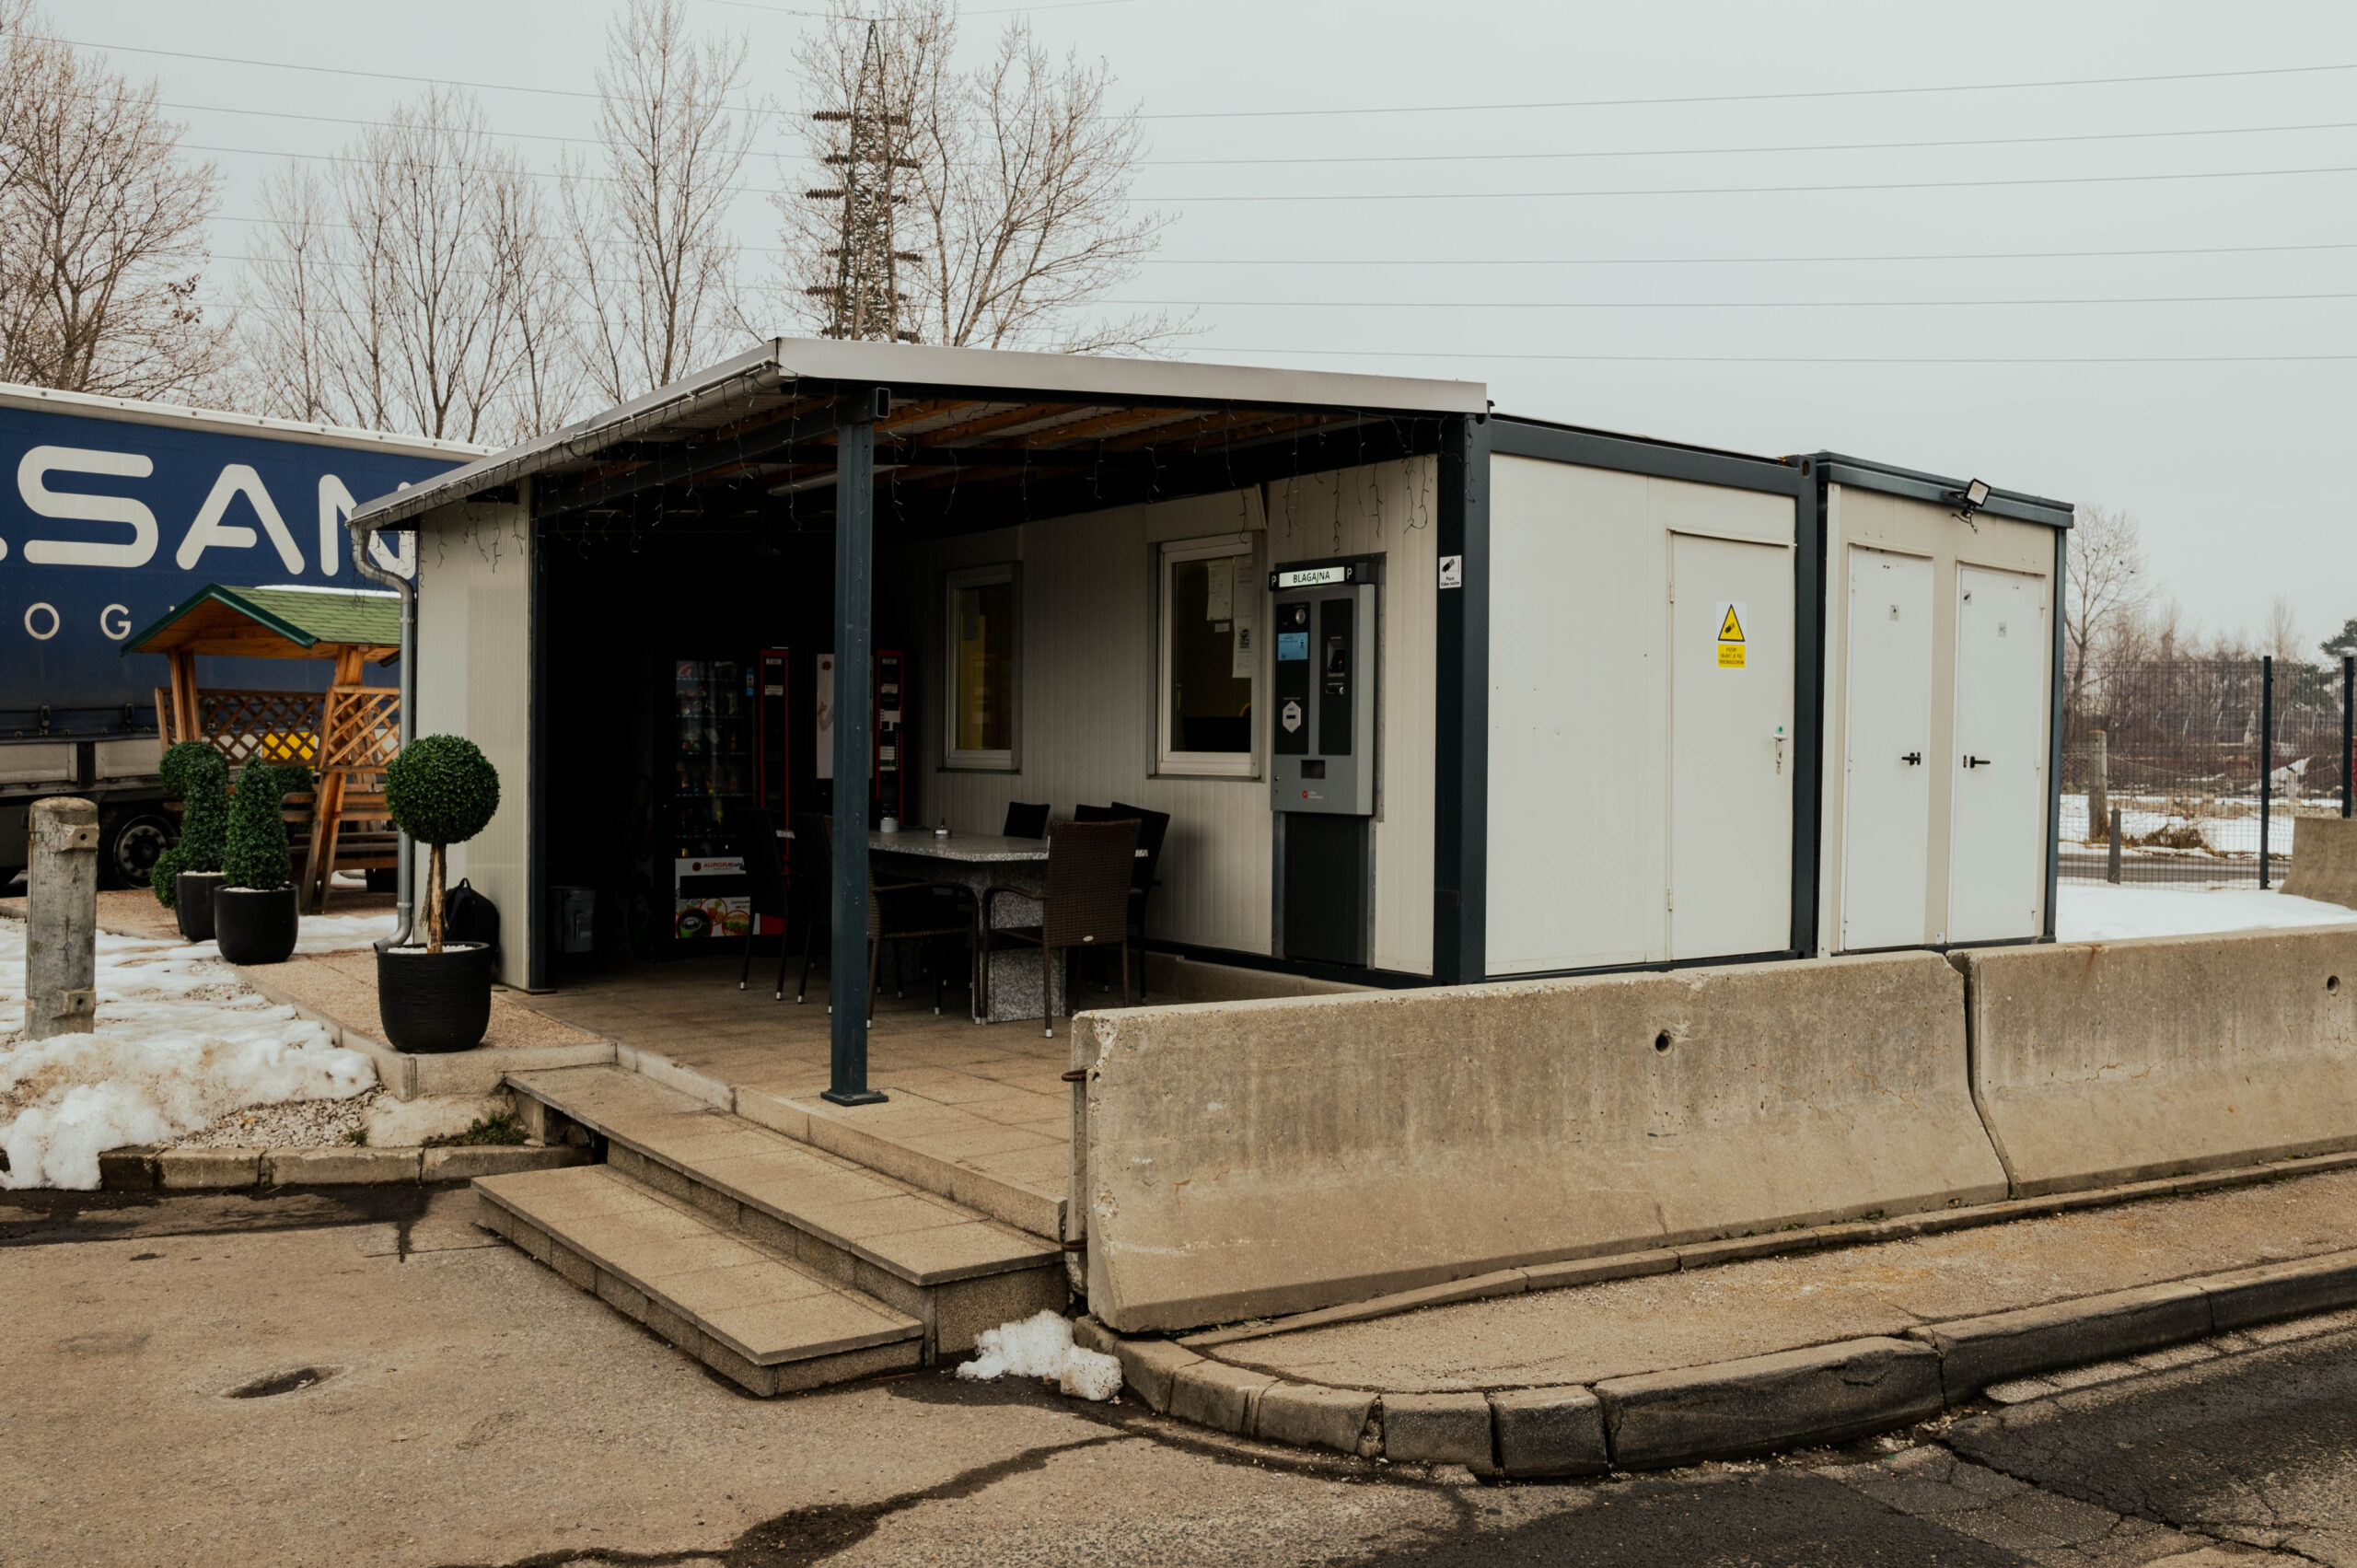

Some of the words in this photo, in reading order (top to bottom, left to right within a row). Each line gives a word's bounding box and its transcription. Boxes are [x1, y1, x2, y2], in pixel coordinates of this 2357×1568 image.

[0, 446, 416, 581] SAN
[1271, 575, 1277, 587] P
[1293, 571, 1330, 584] BLAGAJNA
[1346, 567, 1353, 580] P
[24, 602, 175, 640] OG
